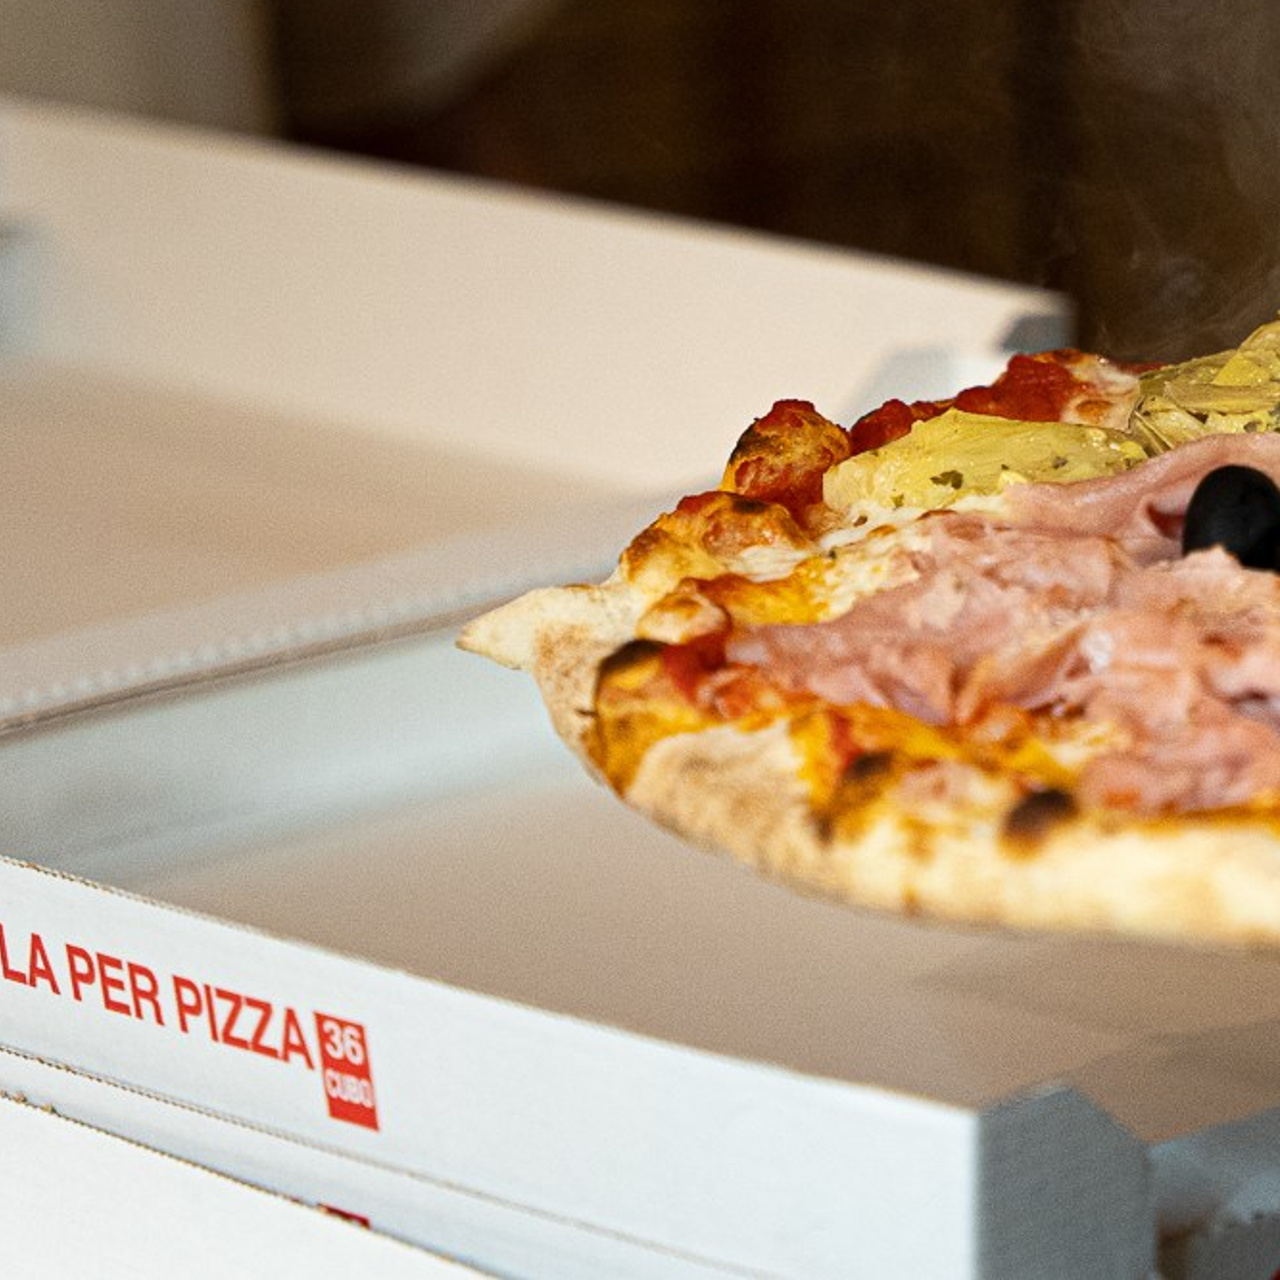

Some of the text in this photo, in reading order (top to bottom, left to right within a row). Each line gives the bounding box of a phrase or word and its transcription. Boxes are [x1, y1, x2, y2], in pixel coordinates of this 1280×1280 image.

[0, 922, 315, 1069] LA PER PIZZA
[323, 1020, 365, 1066] 36
[325, 1068, 376, 1108] CUBO
